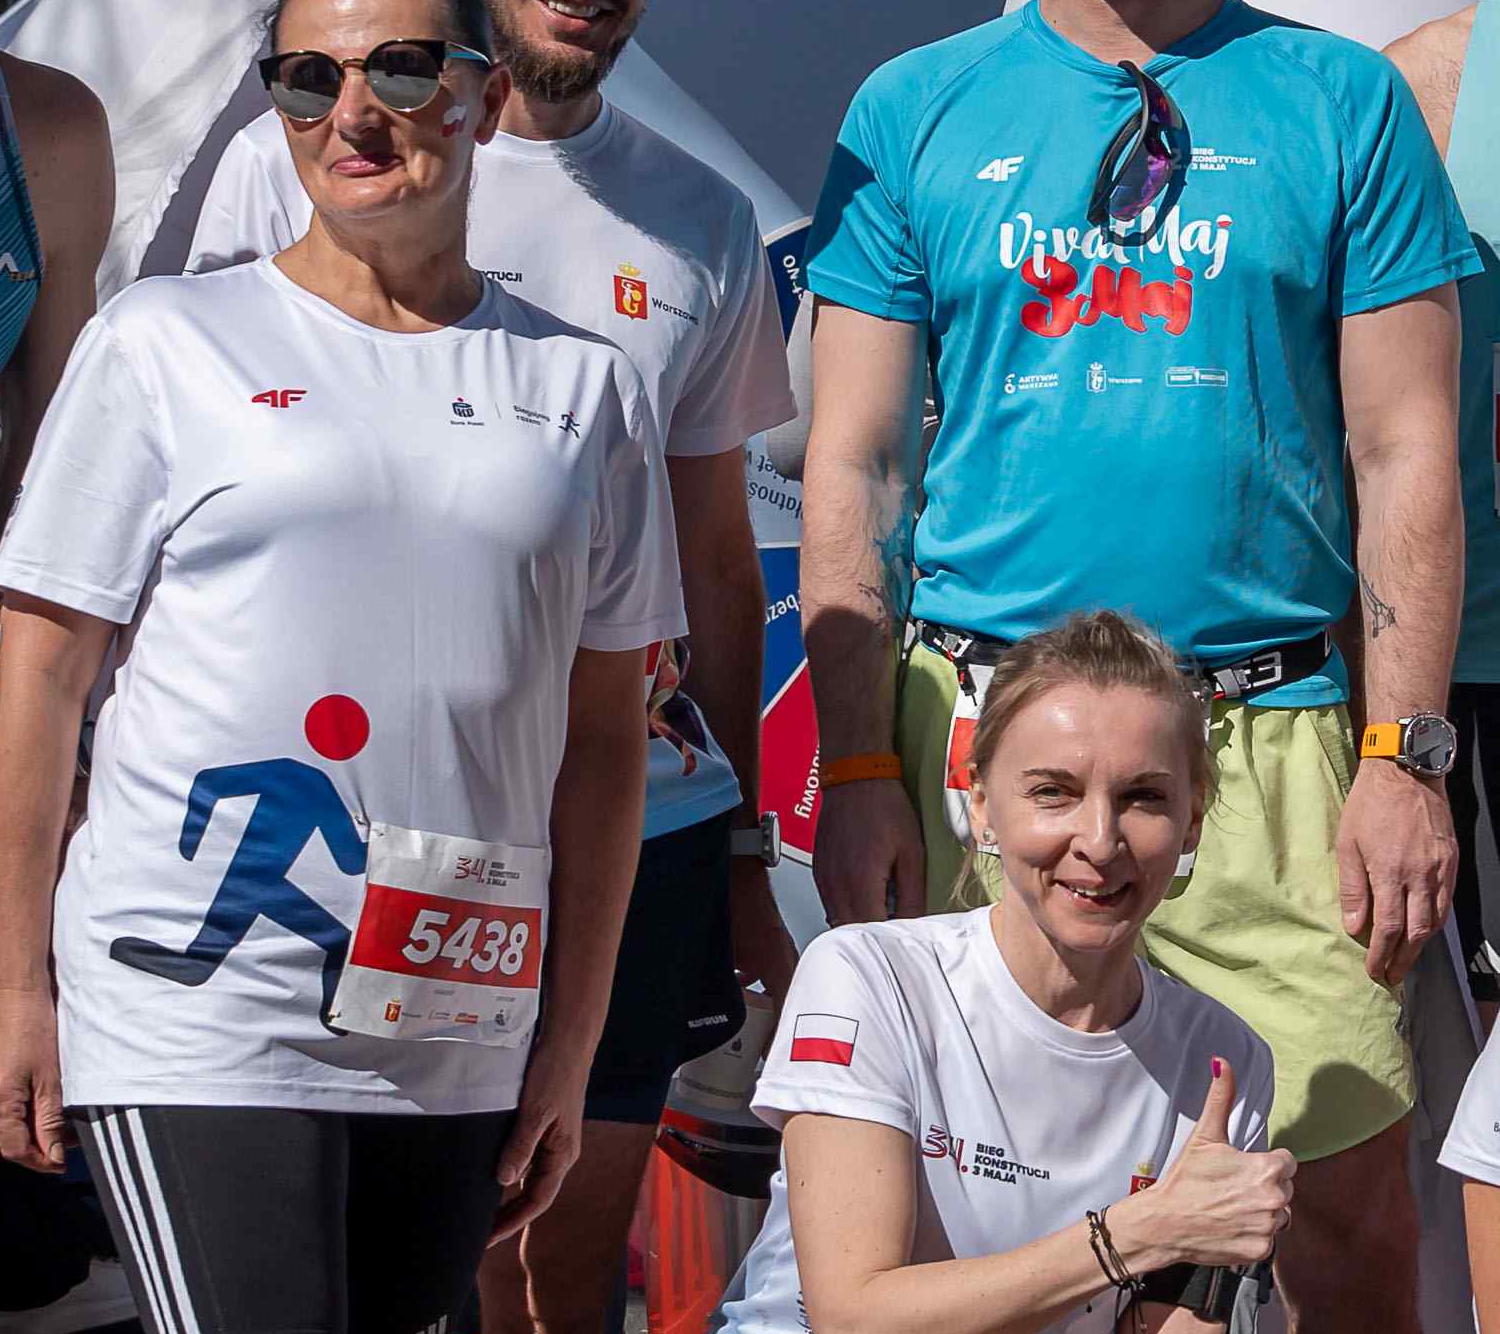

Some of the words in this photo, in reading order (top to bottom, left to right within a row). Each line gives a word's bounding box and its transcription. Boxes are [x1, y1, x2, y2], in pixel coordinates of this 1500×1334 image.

[977, 156, 1024, 182] 4F
[252, 390, 307, 408] 4F
[402, 909, 530, 975] 5438
[976, 1143, 1005, 1158] BIEG
[972, 1165, 980, 1175] 3
[983, 1168, 1017, 1184] MAJA
[974, 1154, 1050, 1180] KONSTYTUCJI
